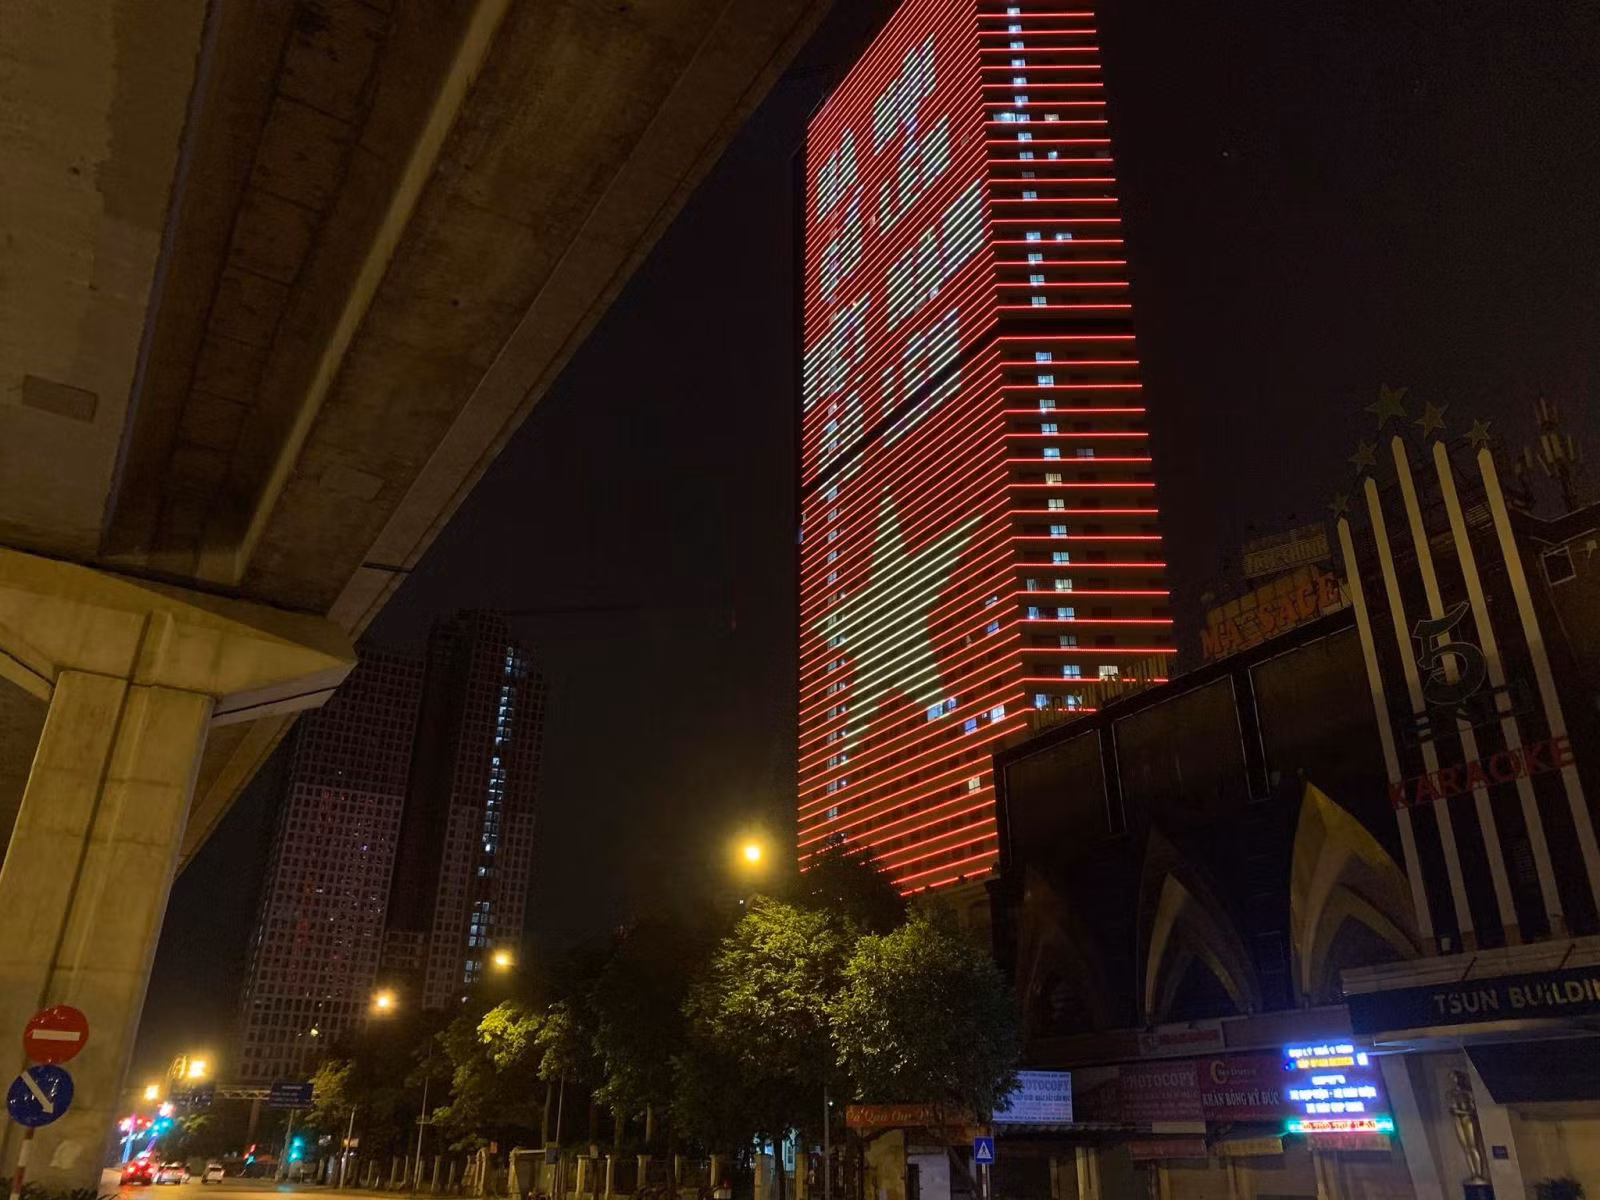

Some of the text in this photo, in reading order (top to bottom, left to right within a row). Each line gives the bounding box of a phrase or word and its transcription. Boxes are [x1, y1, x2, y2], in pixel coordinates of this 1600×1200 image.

[817, 32, 936, 224] HÀ NỘI
[819, 112, 950, 302] CỐ LÊN
[803, 176, 984, 413] VIỆT NAM
[818, 304, 961, 501] CỐ LÊN
[1200, 573, 1339, 661] MASSAGE
[1412, 600, 1487, 704] 5
[1388, 736, 1576, 809] KARAOKE
[1434, 989, 1500, 1015] TSUN
[1123, 1070, 1197, 1089] PHOTOCOPY
